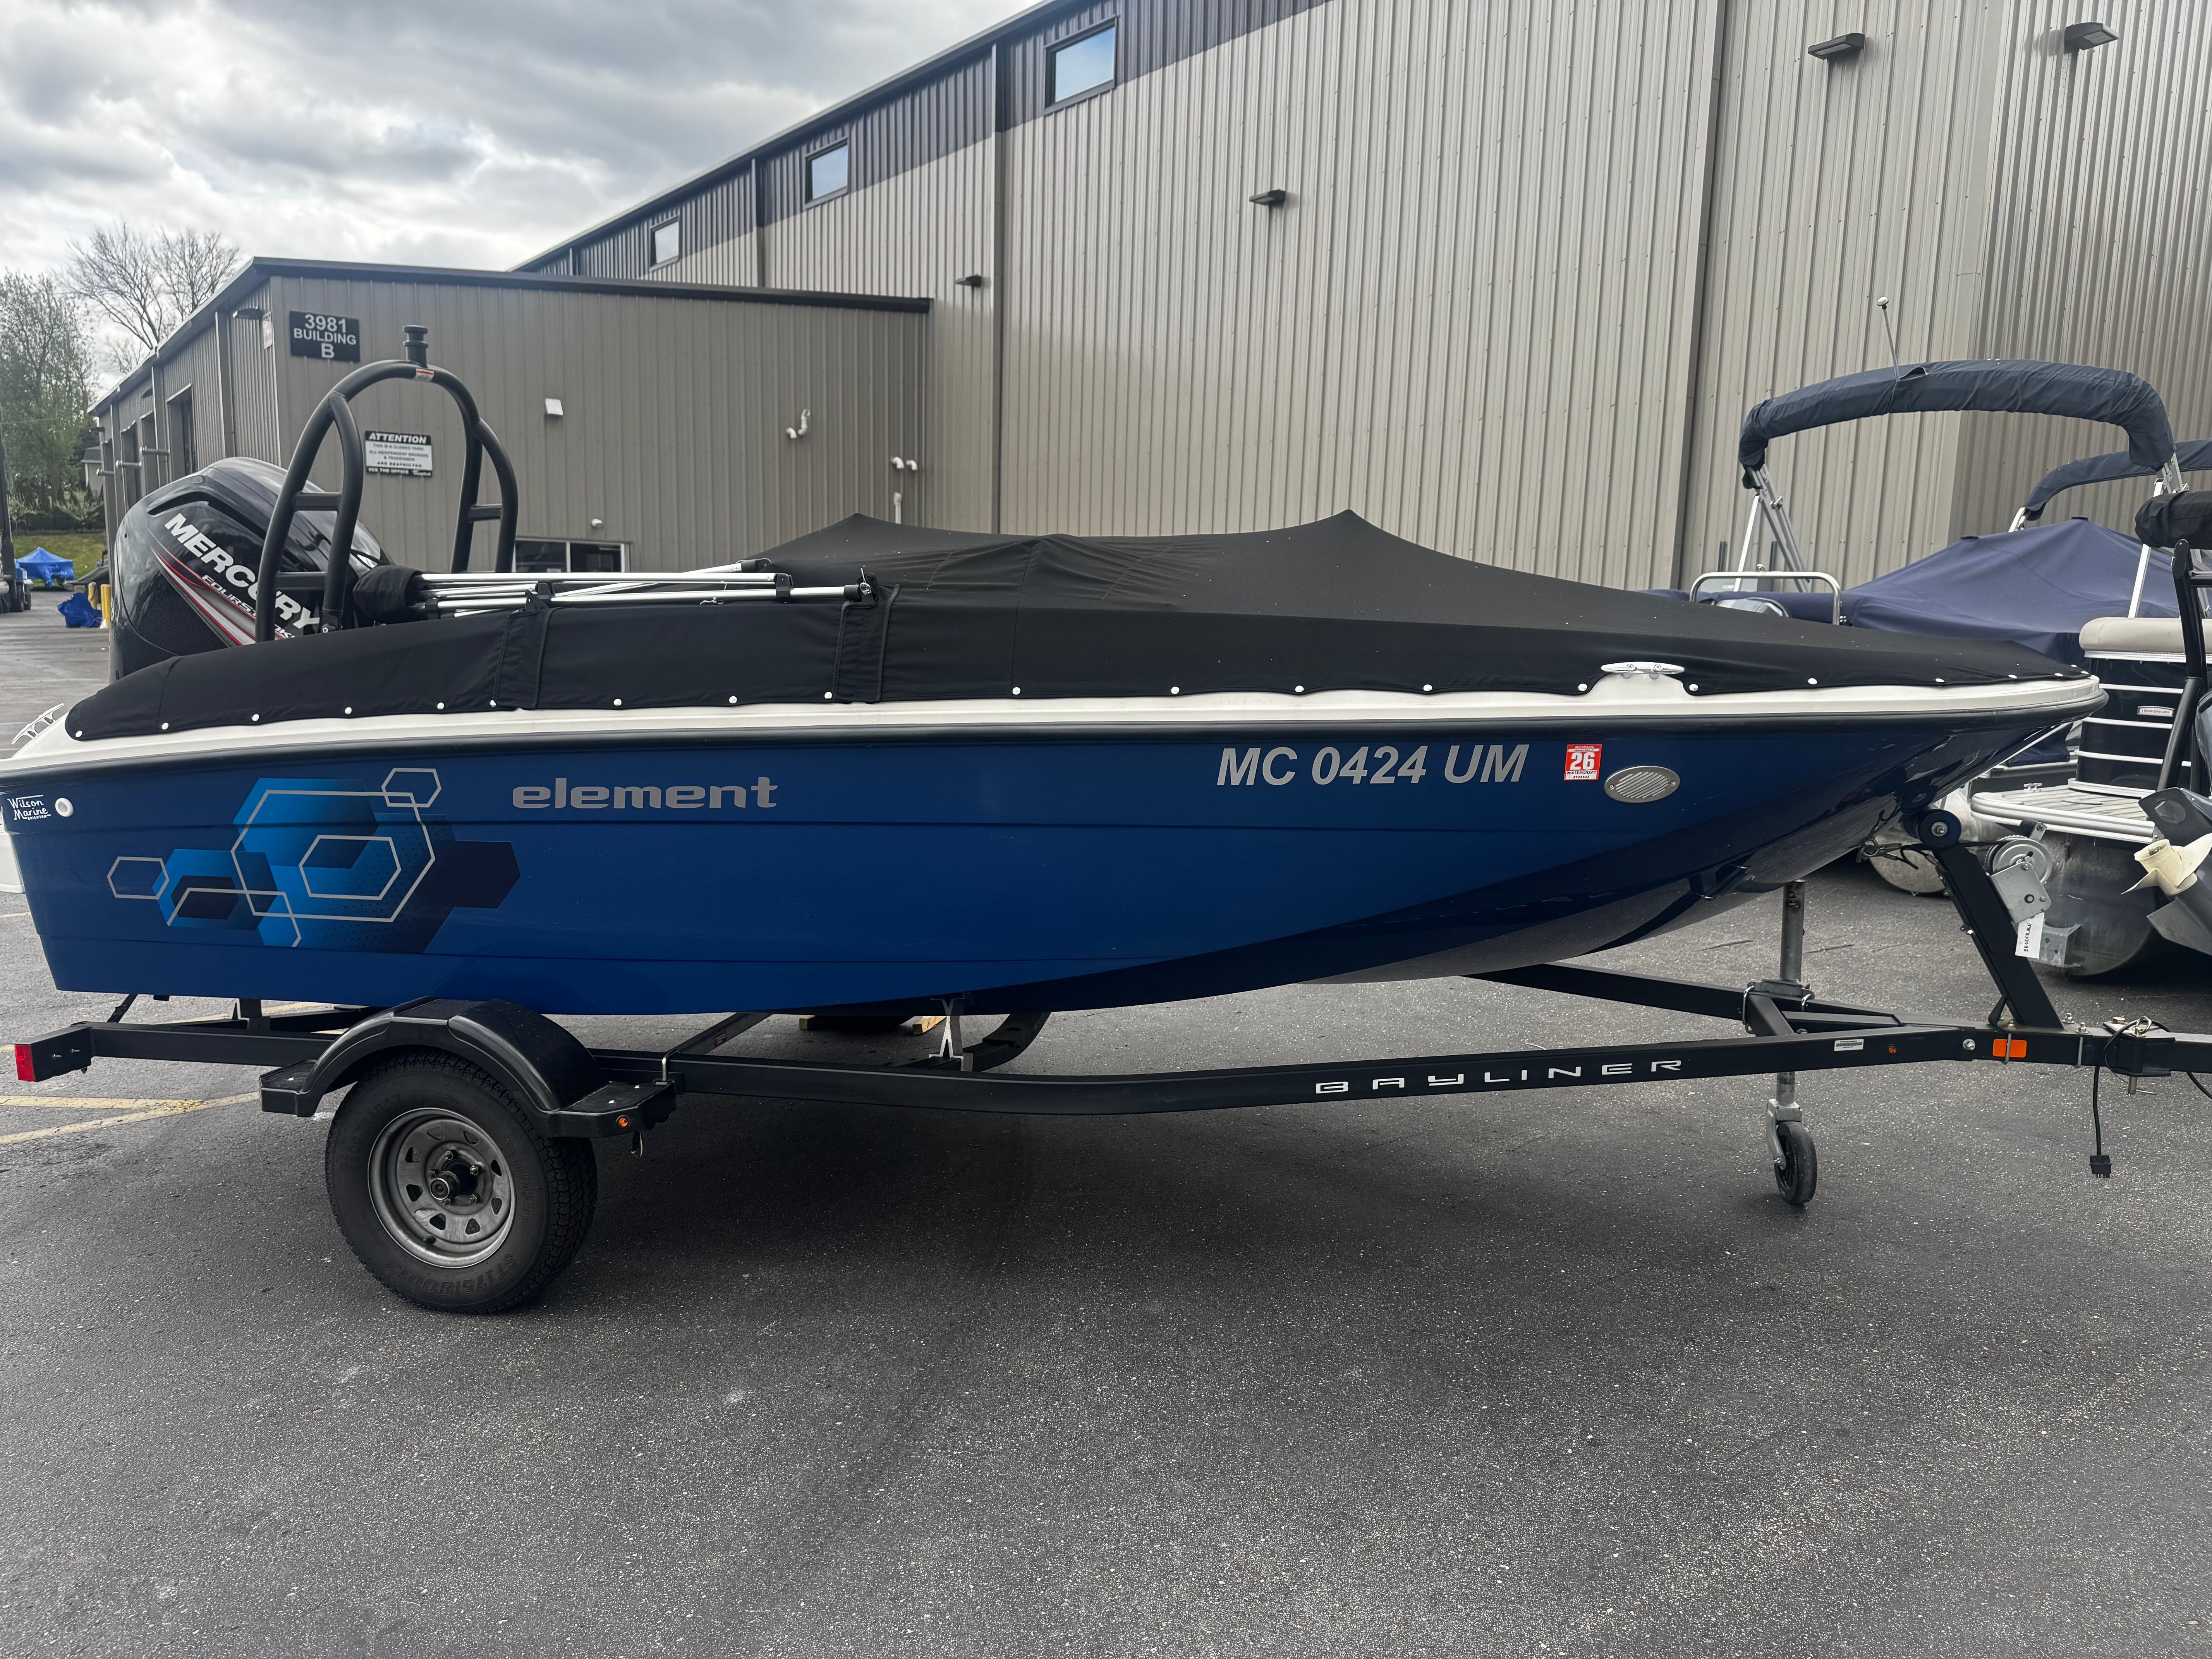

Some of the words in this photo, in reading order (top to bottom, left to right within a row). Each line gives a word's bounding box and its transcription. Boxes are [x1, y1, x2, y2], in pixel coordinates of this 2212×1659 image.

[305, 314, 346, 333] 3981
[294, 328, 357, 345] BUILDING
[321, 342, 335, 359] B
[369, 432, 427, 444] ATTENTION
[1217, 747, 1297, 786] MC
[1312, 745, 1428, 785] 0424
[1444, 744, 1530, 783] UM
[1570, 752, 1595, 770] 26
[513, 776, 778, 809] element
[7, 795, 44, 809] Wilson
[14, 807, 48, 820] Marine
[1316, 1060, 1681, 1094] BAYLINER
